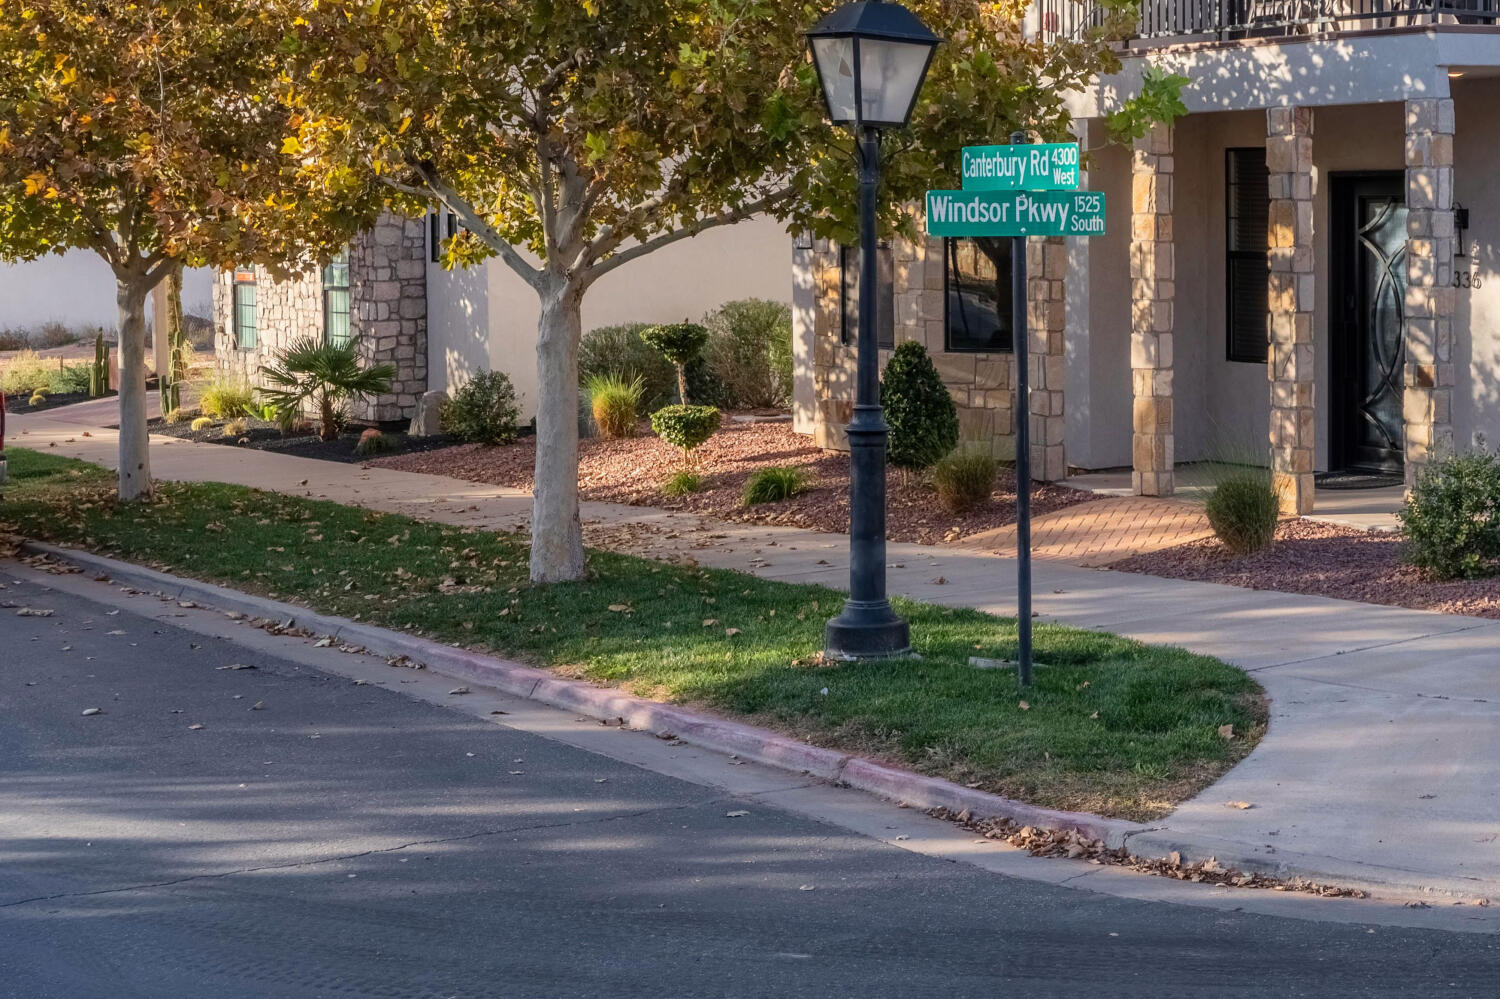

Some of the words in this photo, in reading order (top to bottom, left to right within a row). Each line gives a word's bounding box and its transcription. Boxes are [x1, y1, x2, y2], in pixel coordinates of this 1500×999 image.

[1051, 147, 1077, 166] 4300
[963, 151, 1027, 185] Canterbury
[1030, 149, 1049, 176] Rd
[1053, 167, 1075, 185] West
[930, 195, 1010, 223] Windsor
[1016, 196, 1069, 231] Pkwy
[1074, 196, 1100, 213] 1525
[1071, 215, 1104, 231] South
